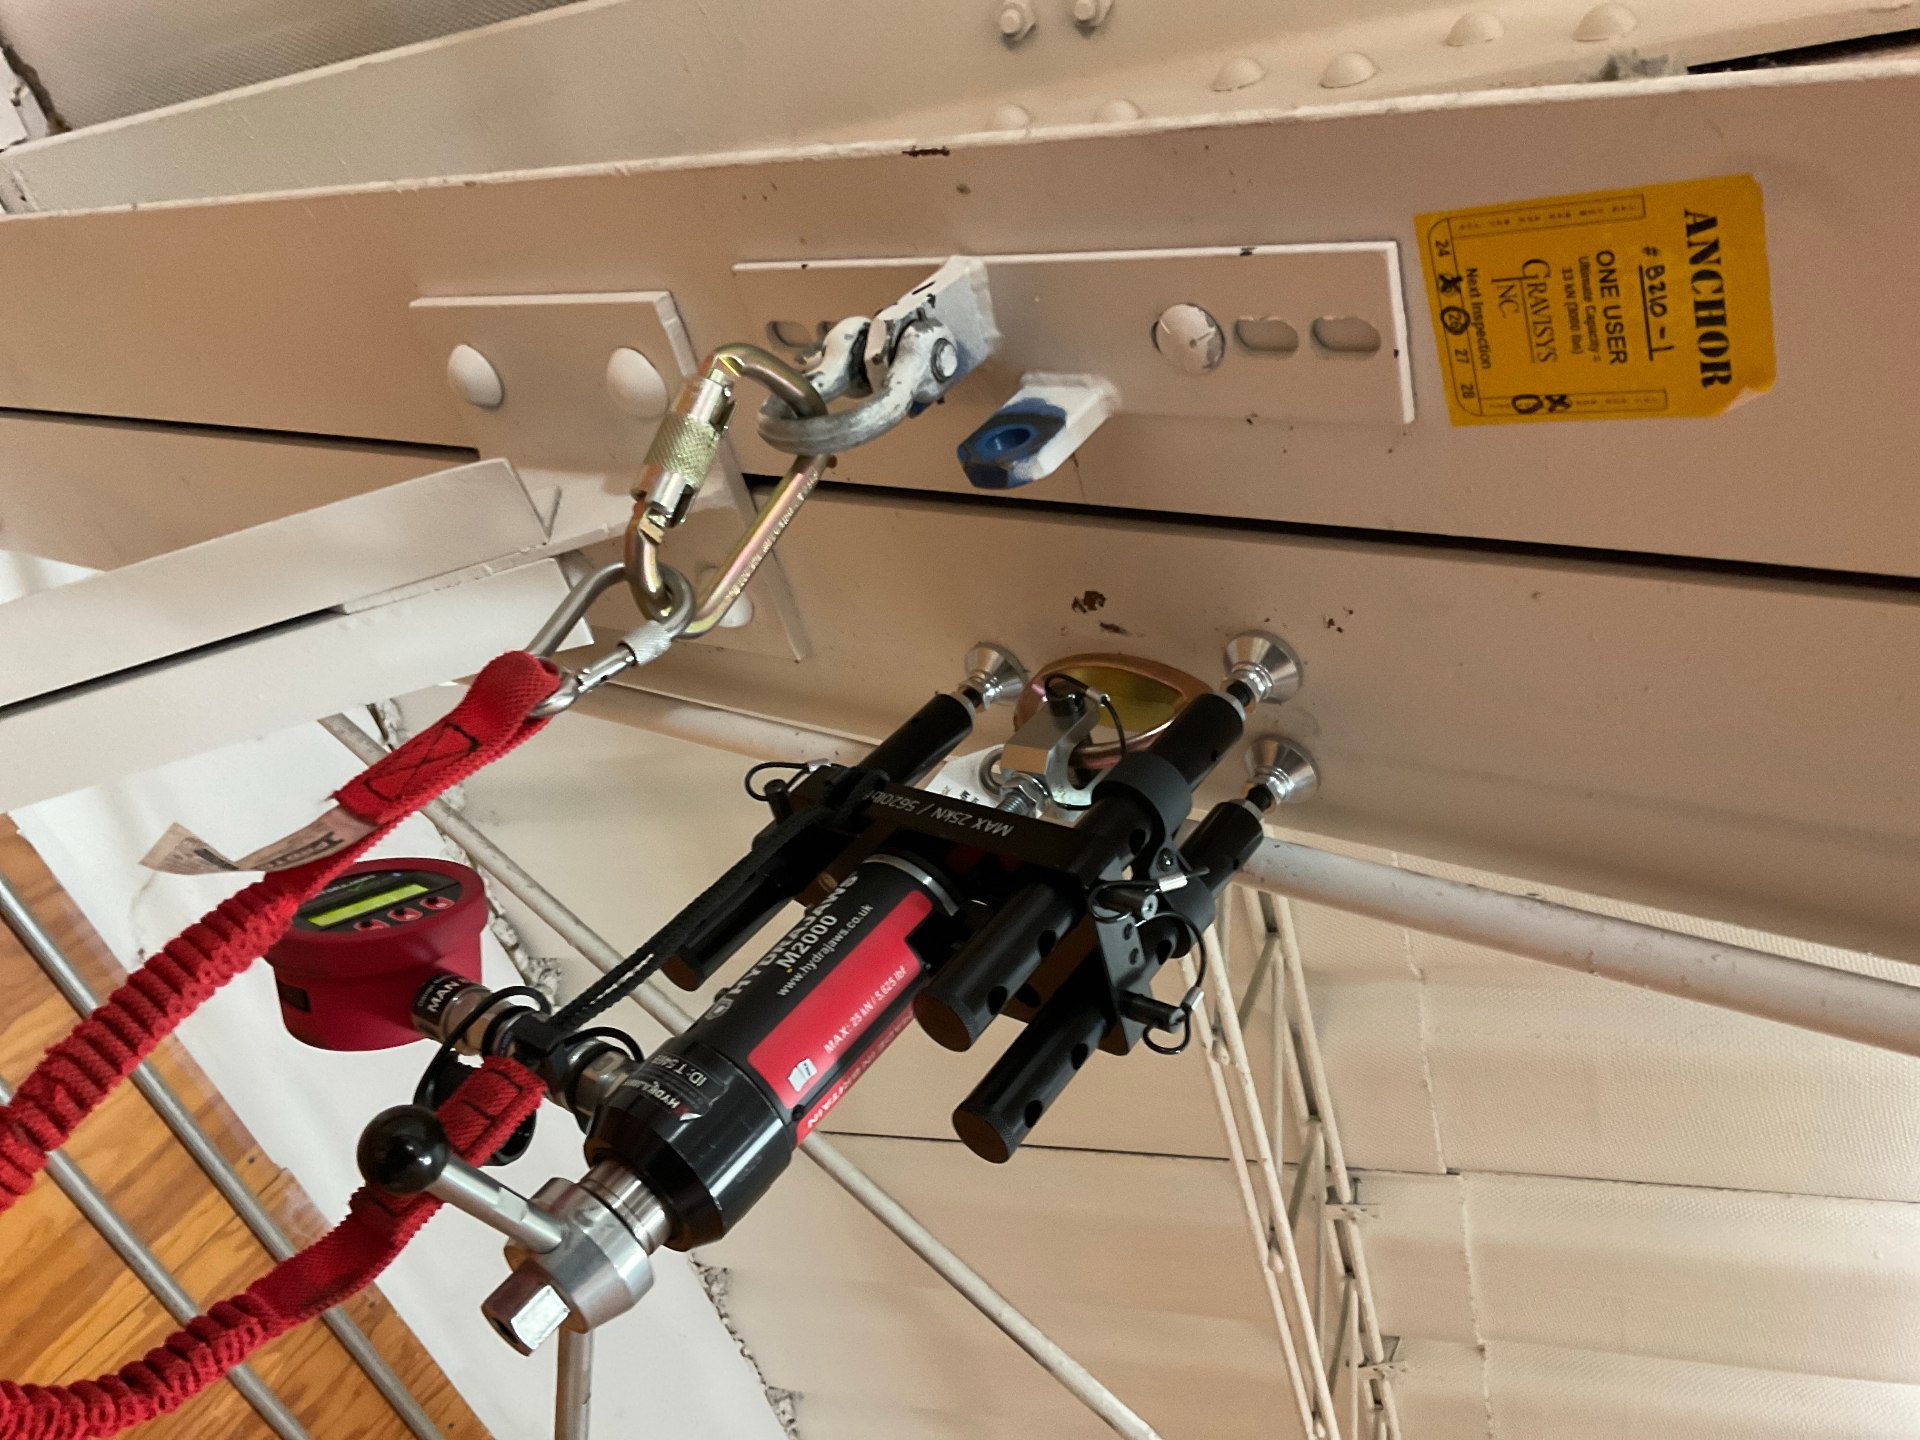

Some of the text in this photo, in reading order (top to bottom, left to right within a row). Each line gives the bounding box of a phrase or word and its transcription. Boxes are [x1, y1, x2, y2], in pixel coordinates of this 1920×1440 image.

[1435, 240, 1450, 257] 24
[1578, 255, 1593, 302] Ultimate
[1684, 208, 1732, 388] ANCHOR
[1466, 267, 1492, 370] Next Inspection
[1522, 258, 1559, 363] GRAVISYS
[1583, 304, 1599, 353] Capacity
[1596, 250, 1628, 365] ONE USER
[1454, 348, 1470, 364] 27
[1460, 383, 1475, 399] 28
[932, 807, 973, 826] 25kN
[971, 817, 1015, 837] MAX
[775, 915, 838, 969] M2000
[776, 903, 874, 997] www.hydrajaws.co.uk
[426, 981, 460, 1013] MAN
[687, 1068, 708, 1087] ID:
